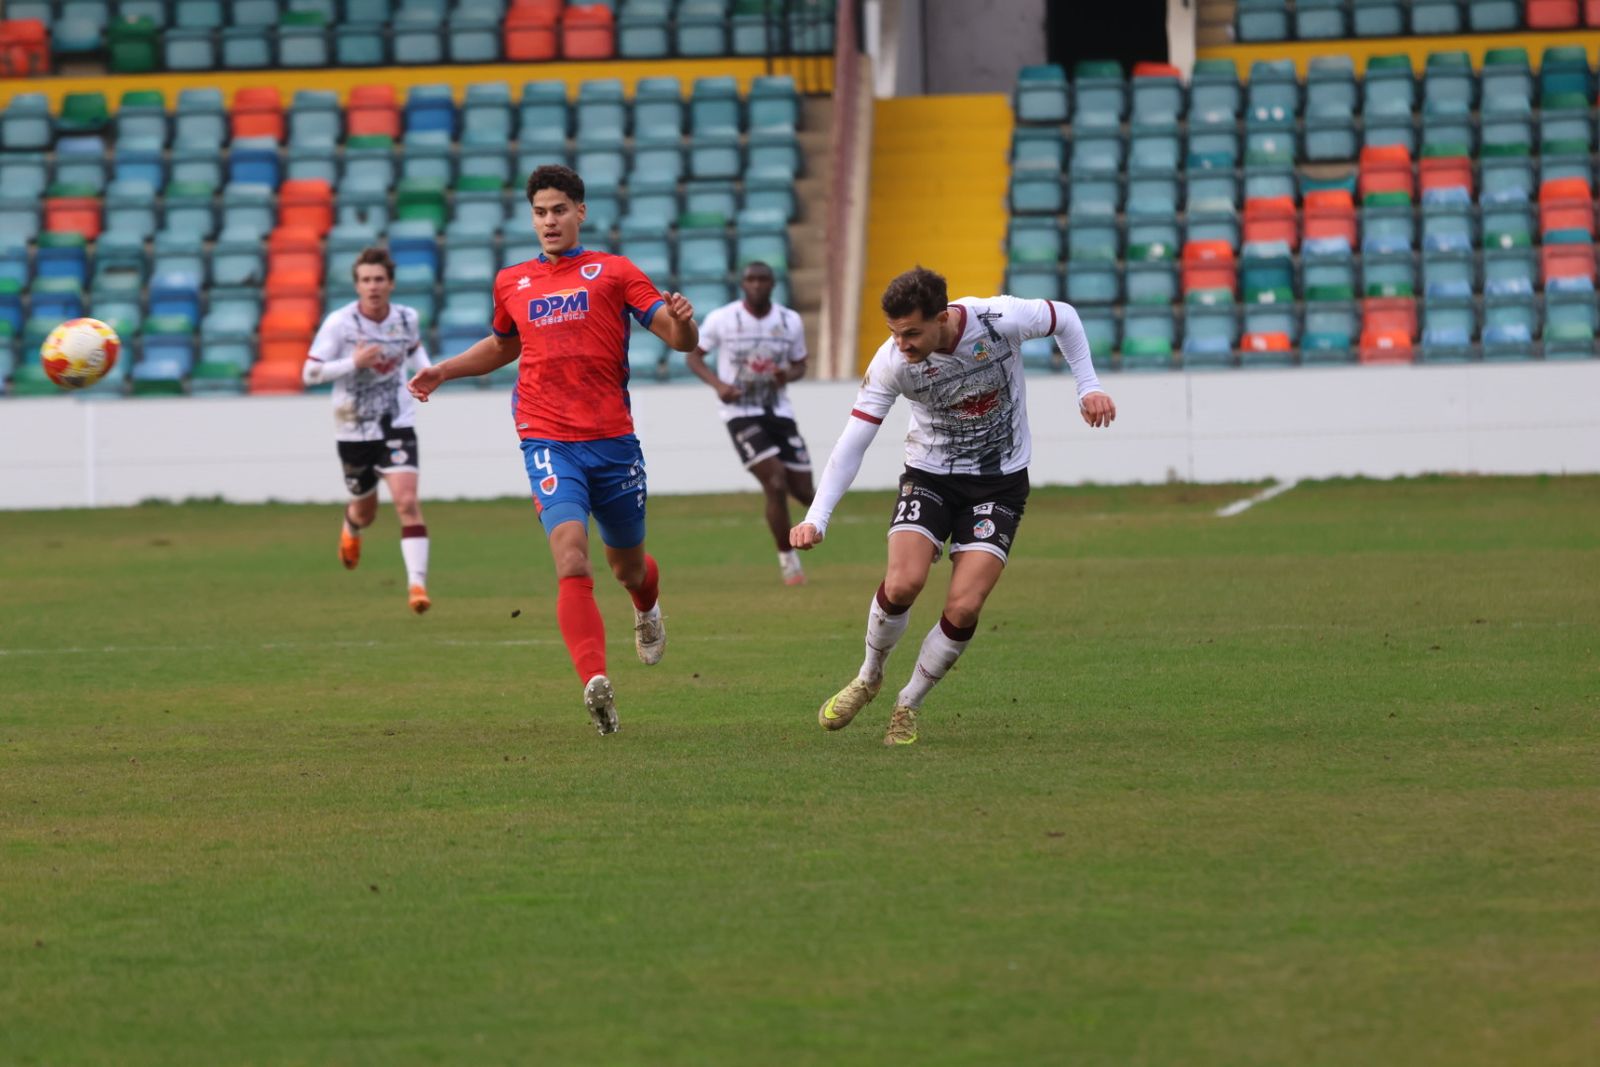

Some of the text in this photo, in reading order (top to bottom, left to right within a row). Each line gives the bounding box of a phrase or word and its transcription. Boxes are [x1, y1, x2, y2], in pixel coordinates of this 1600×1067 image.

[528, 289, 590, 322] DPM
[535, 312, 586, 327] LOGISTICA
[533, 448, 553, 475] 4
[894, 500, 921, 523] 23
